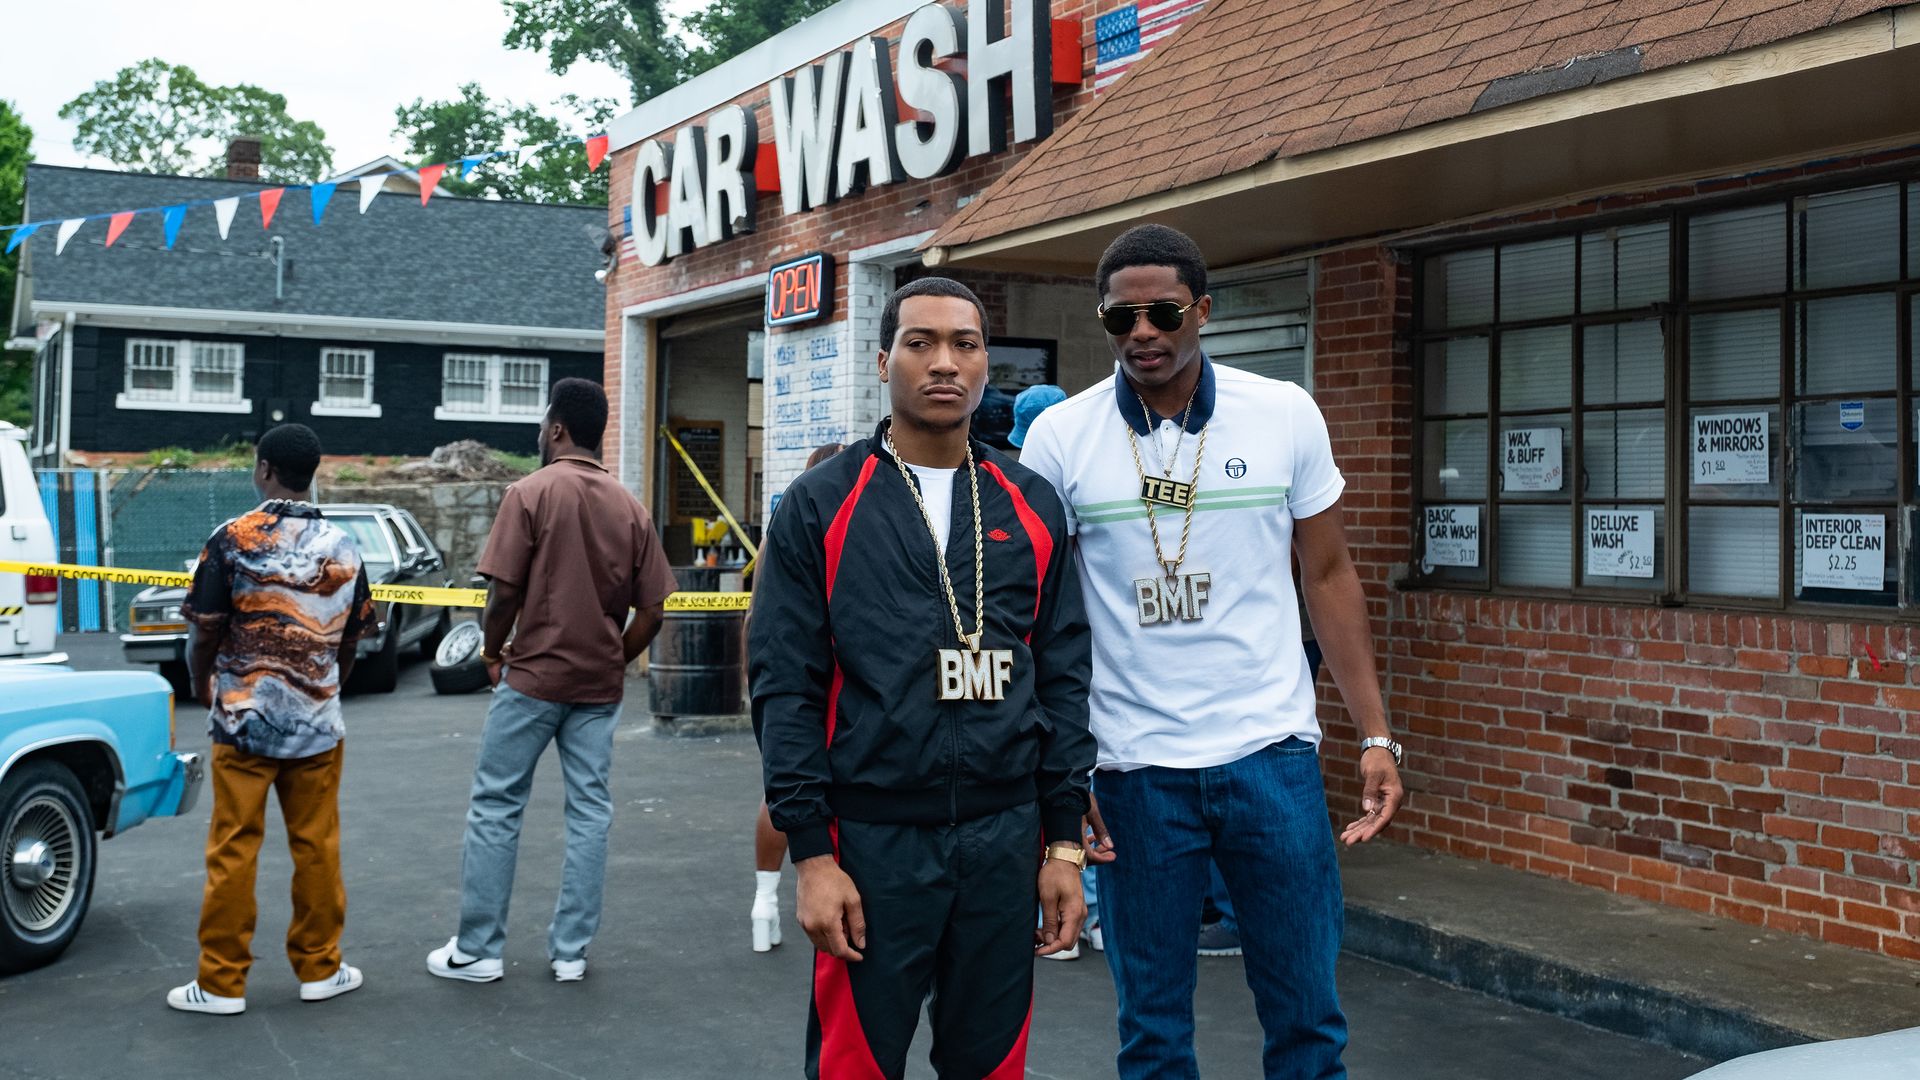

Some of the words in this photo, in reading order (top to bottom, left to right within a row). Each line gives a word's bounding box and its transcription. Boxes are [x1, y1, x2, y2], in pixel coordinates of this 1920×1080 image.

[632, 104, 756, 267] CAR
[770, 0, 1048, 216] WASH
[772, 263, 820, 318] OPEN
[811, 336, 838, 357] DETAIL
[1697, 417, 1761, 436] WINDOWS
[1508, 432, 1532, 447] WAX
[1697, 437, 1707, 453] &
[1710, 434, 1765, 453] MIRRORS
[1507, 448, 1516, 464] &
[1517, 447, 1546, 464] BUFF
[1145, 478, 1190, 505] TEE
[1428, 509, 1456, 523] BASIC
[1591, 515, 1639, 532] DELUXE
[1429, 524, 1448, 539] CAR
[1450, 525, 1477, 540] WASH
[1805, 518, 1862, 534] INTERIOR
[1591, 533, 1624, 549] WASH
[1806, 534, 1837, 549] DEEP
[1840, 535, 1881, 551] CLEAN
[1828, 553, 1857, 571] $2.25
[27, 566, 69, 578] CRIME
[1135, 573, 1211, 626] BMF
[937, 649, 1014, 701] BMF
